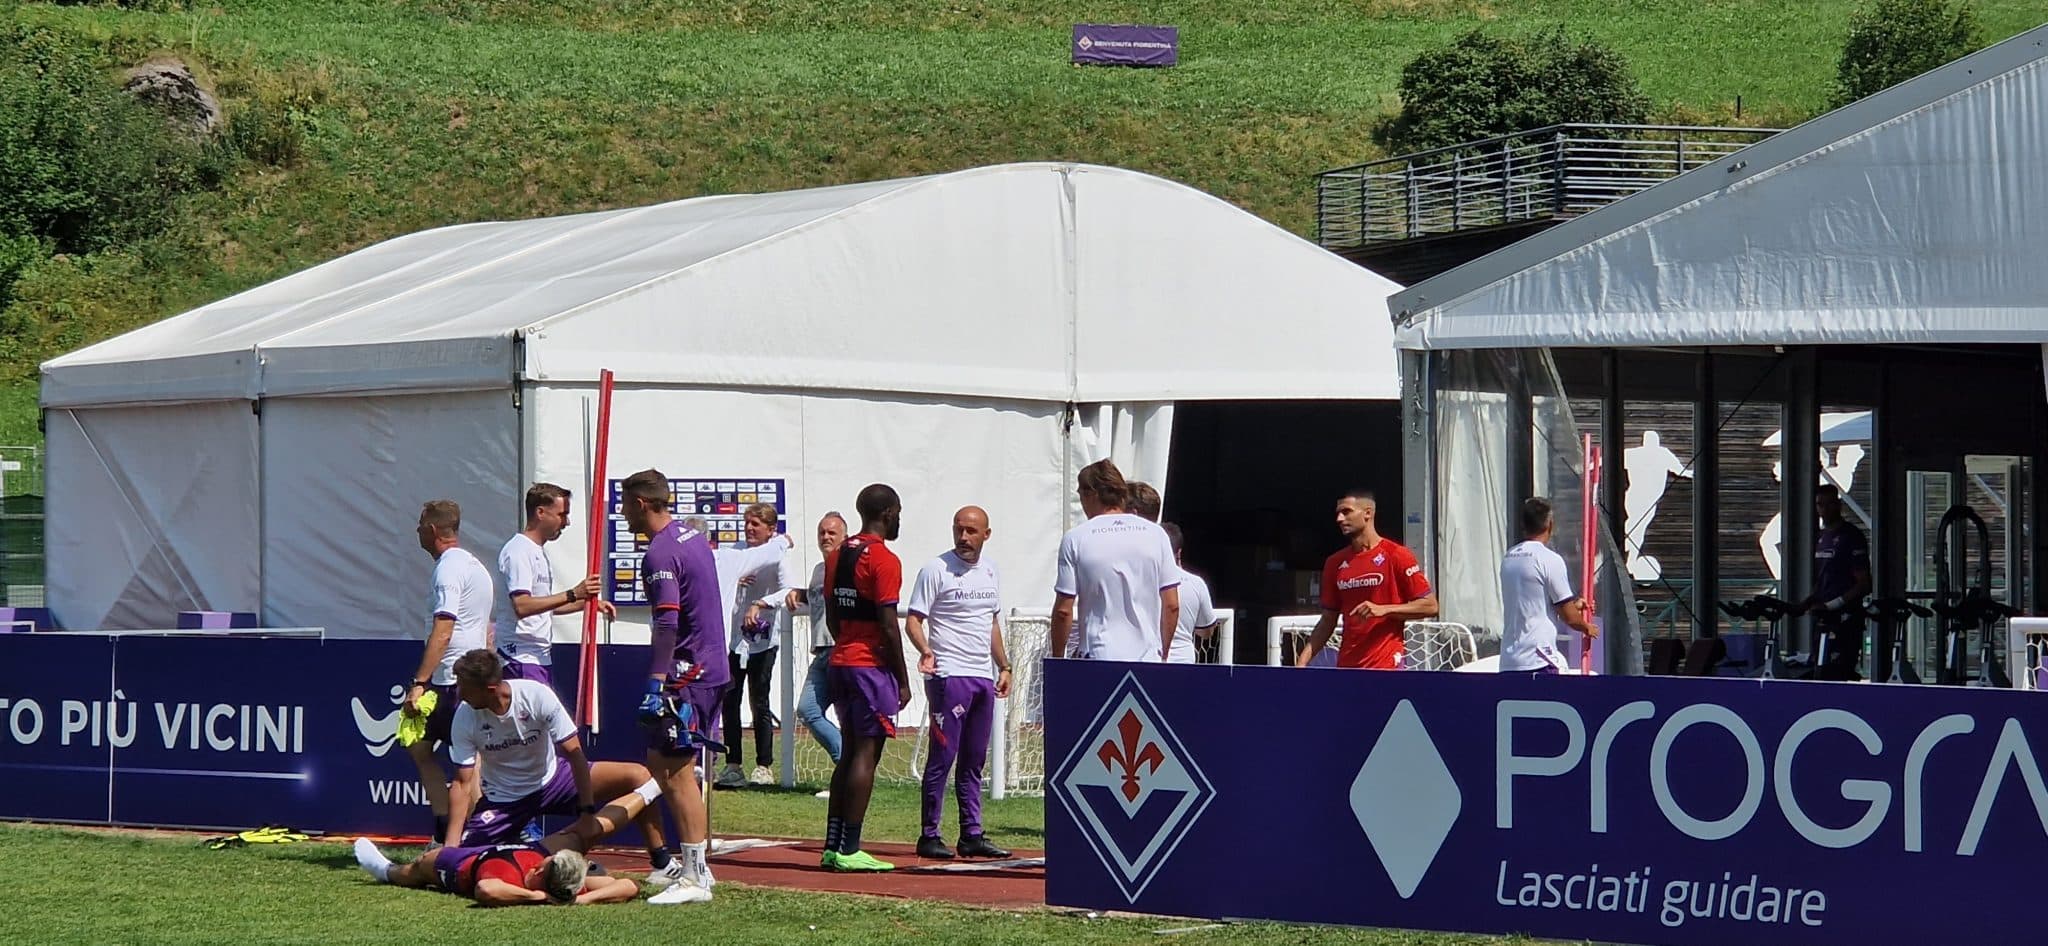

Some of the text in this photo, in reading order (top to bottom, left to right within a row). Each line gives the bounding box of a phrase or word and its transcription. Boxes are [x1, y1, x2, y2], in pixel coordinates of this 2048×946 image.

[0, 690, 304, 753] O PIÙ VICINI
[1496, 860, 1826, 926] Lasciati guidare
